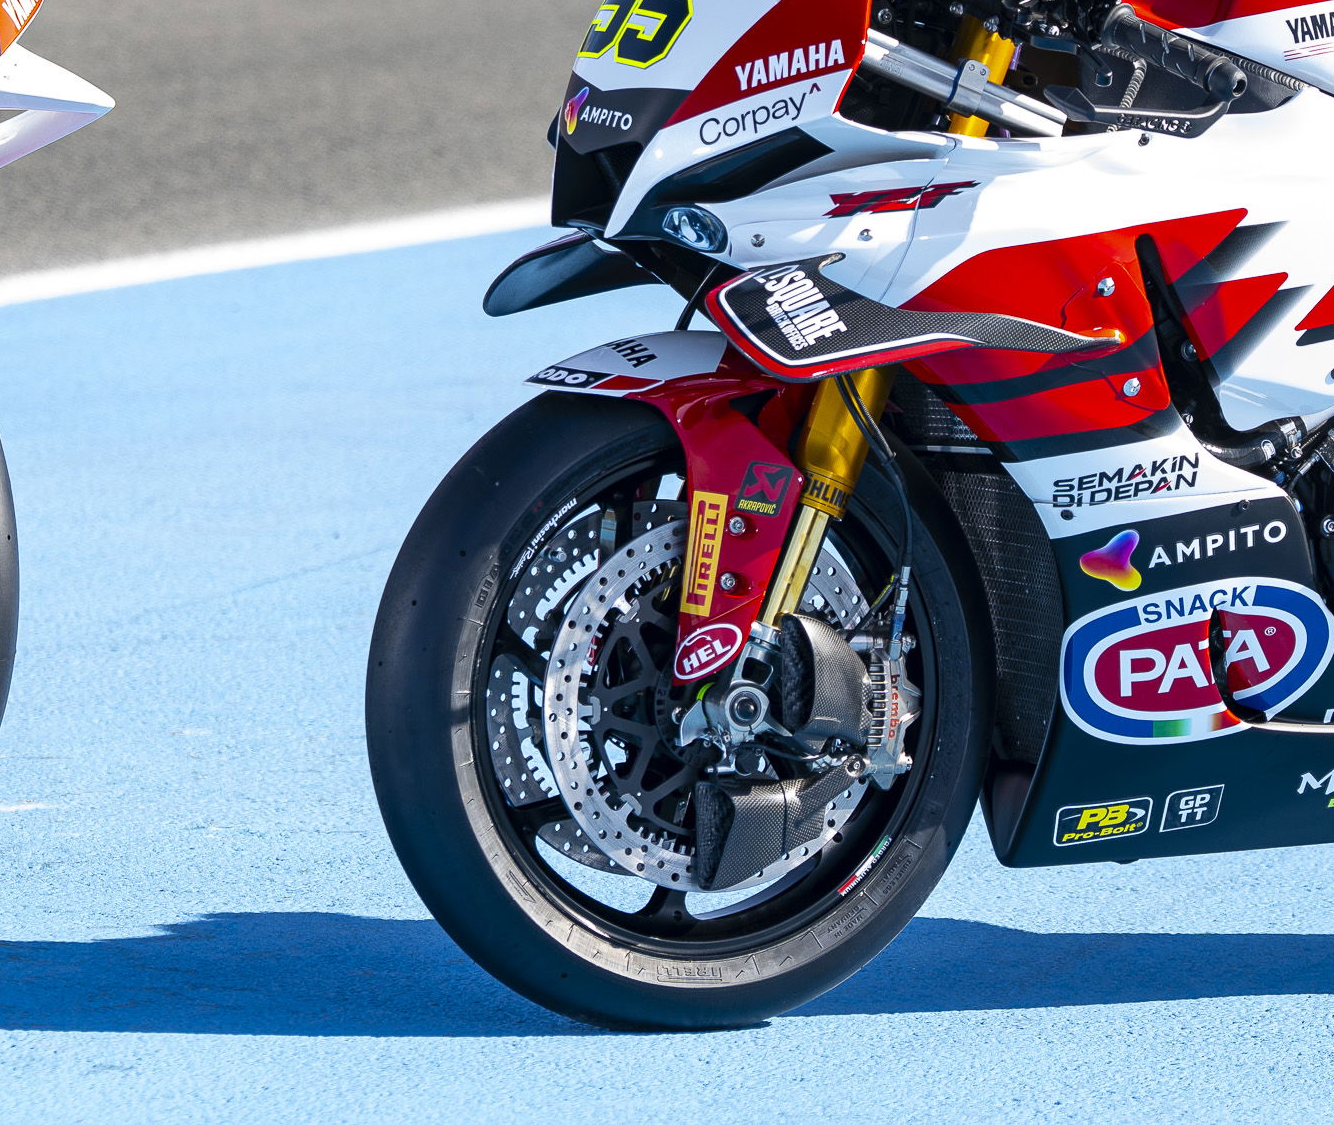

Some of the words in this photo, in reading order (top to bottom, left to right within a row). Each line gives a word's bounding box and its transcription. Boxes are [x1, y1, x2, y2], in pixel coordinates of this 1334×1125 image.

[735, 38, 846, 91] YAMAHA
[580, 105, 633, 130] AMPITO
[765, 302, 792, 329] BRICK
[781, 323, 809, 351] OFFICES
[607, 339, 658, 368] AHA
[533, 368, 588, 384] ODO
[1052, 452, 1200, 493] SEMAKIN
[1052, 491, 1084, 508] DI
[1087, 471, 1198, 504] DEPAN
[531, 497, 578, 552] marchesini
[686, 500, 722, 607] PIRELLI
[1148, 520, 1287, 569] AMPITO
[1142, 586, 1252, 625] SNACK
[682, 637, 732, 675] HEL
[890, 673, 900, 739] brembo
[1076, 804, 1130, 830] PB
[1178, 807, 1208, 823] TT
[1179, 793, 1211, 810] GP
[873, 837, 893, 864] FORGED
[1061, 824, 1137, 842] Pro-Bolt
[841, 863, 874, 897] ALUMINIUM
